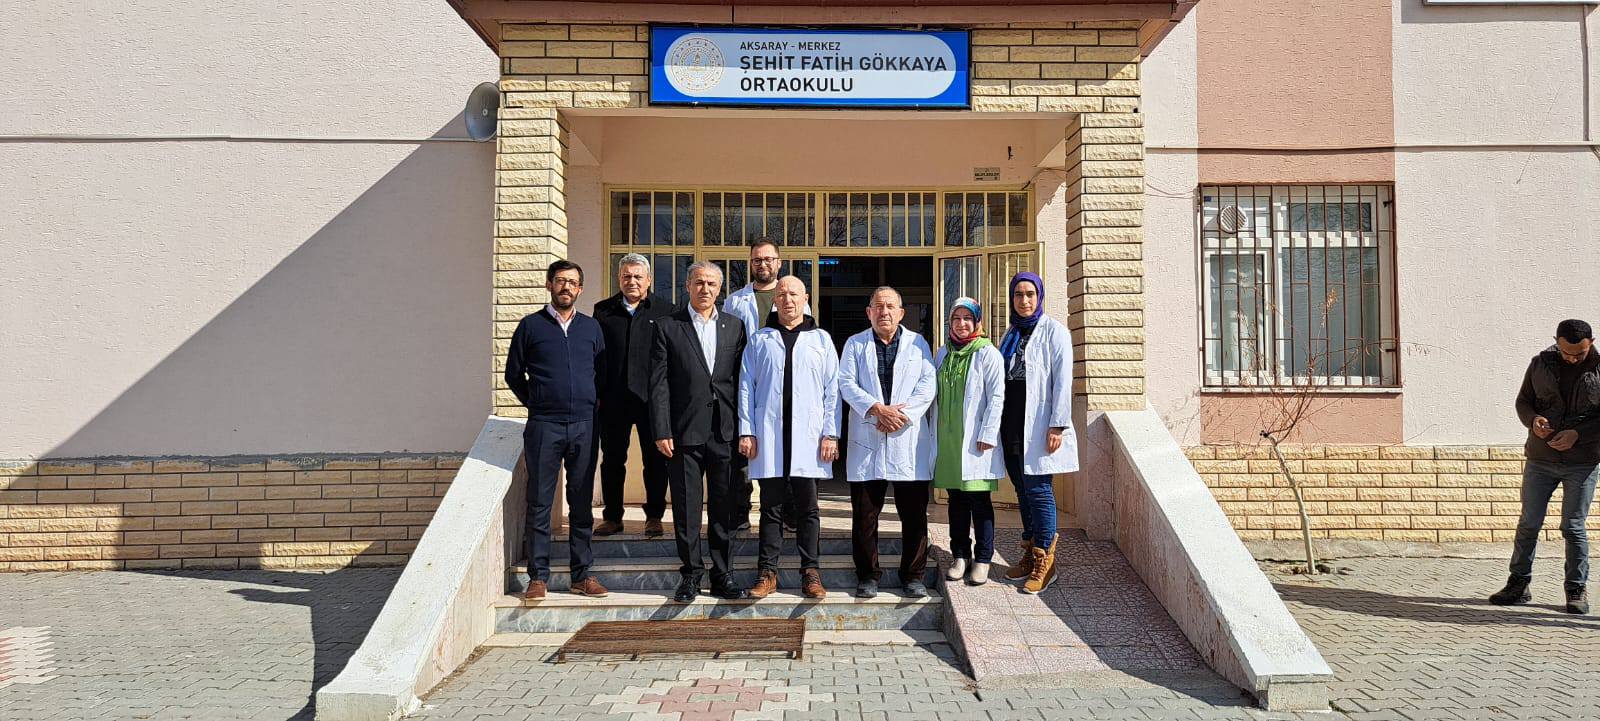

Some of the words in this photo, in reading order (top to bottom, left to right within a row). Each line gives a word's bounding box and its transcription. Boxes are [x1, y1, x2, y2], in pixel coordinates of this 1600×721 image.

[740, 41, 788, 51] AKSARAY
[798, 41, 841, 51] MERKEZ
[740, 52, 795, 74] ŞEHİT
[801, 52, 853, 71] FATİH
[859, 52, 947, 71] GÖKKAYA
[740, 77, 853, 92] ORTAOKULU
